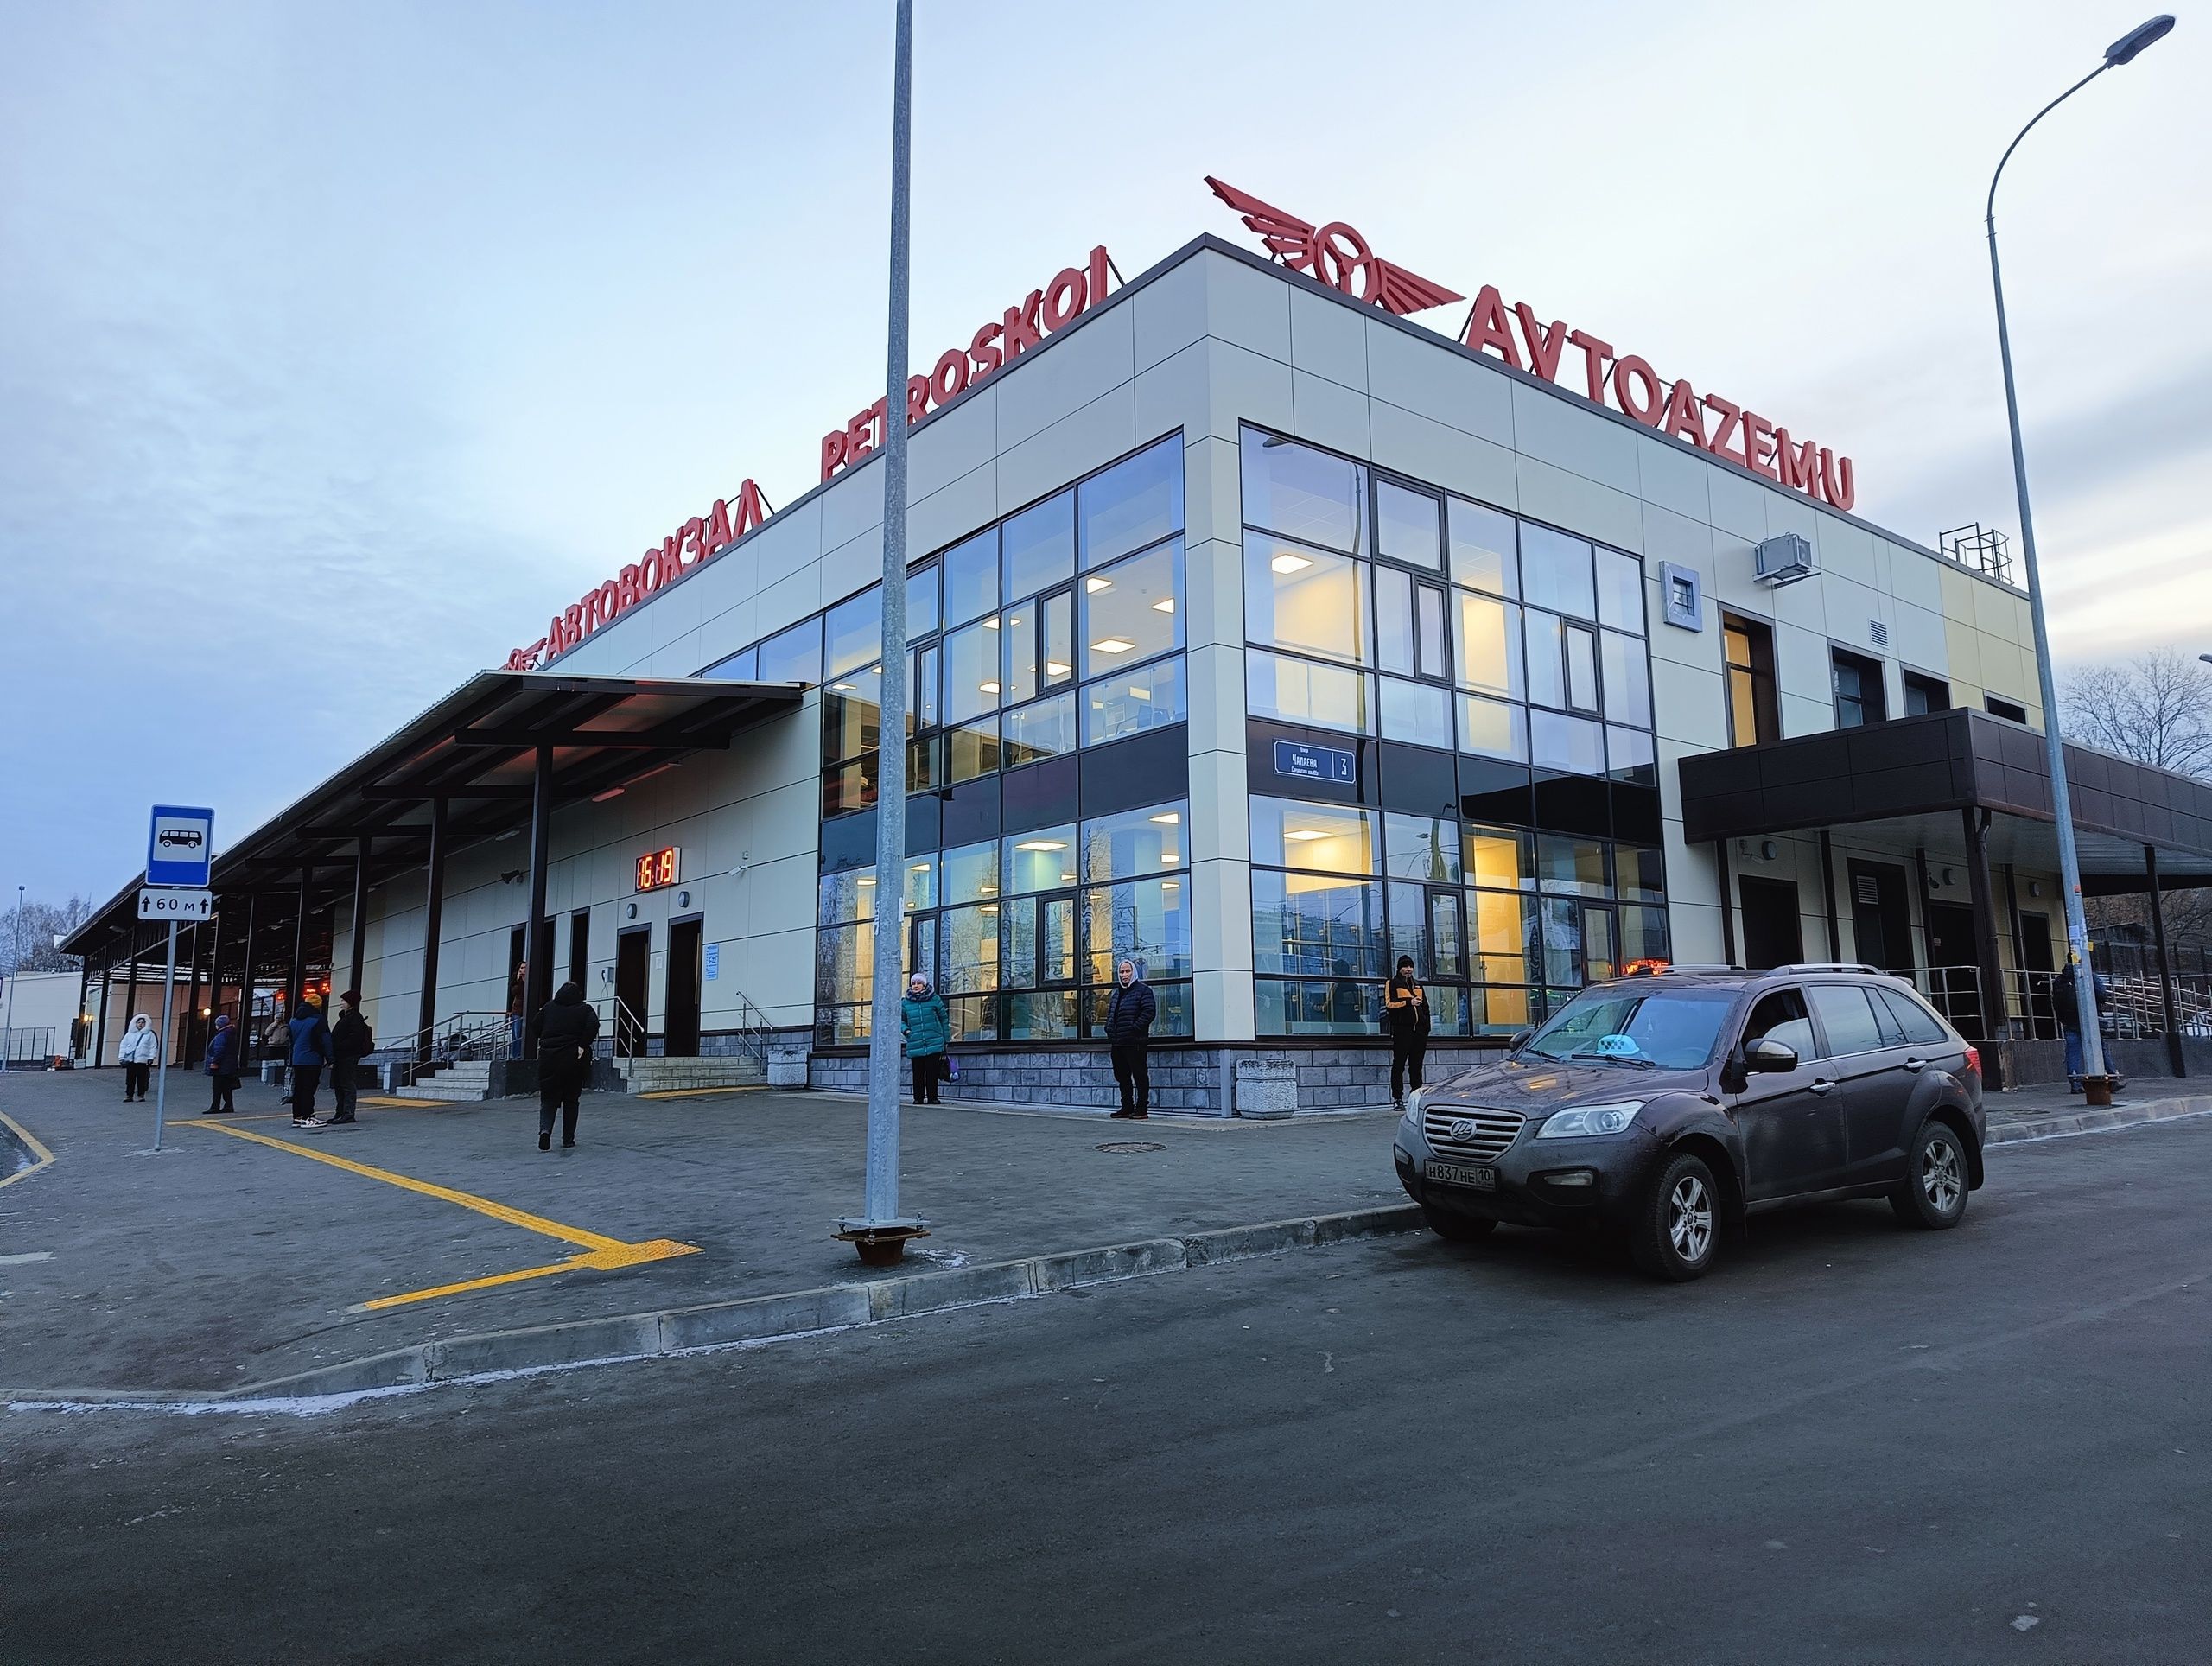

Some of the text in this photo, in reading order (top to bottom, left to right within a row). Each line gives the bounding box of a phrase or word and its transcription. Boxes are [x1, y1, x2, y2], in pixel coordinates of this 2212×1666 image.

[821, 245, 1107, 484] PETROSKOI
[1465, 283, 1855, 512] AVTOAZEMU
[544, 478, 764, 661] АВТОВОКЗАЛ
[1340, 758, 1347, 776] 3
[156, 898, 178, 911] 60
[639, 849, 673, 888] 16:19
